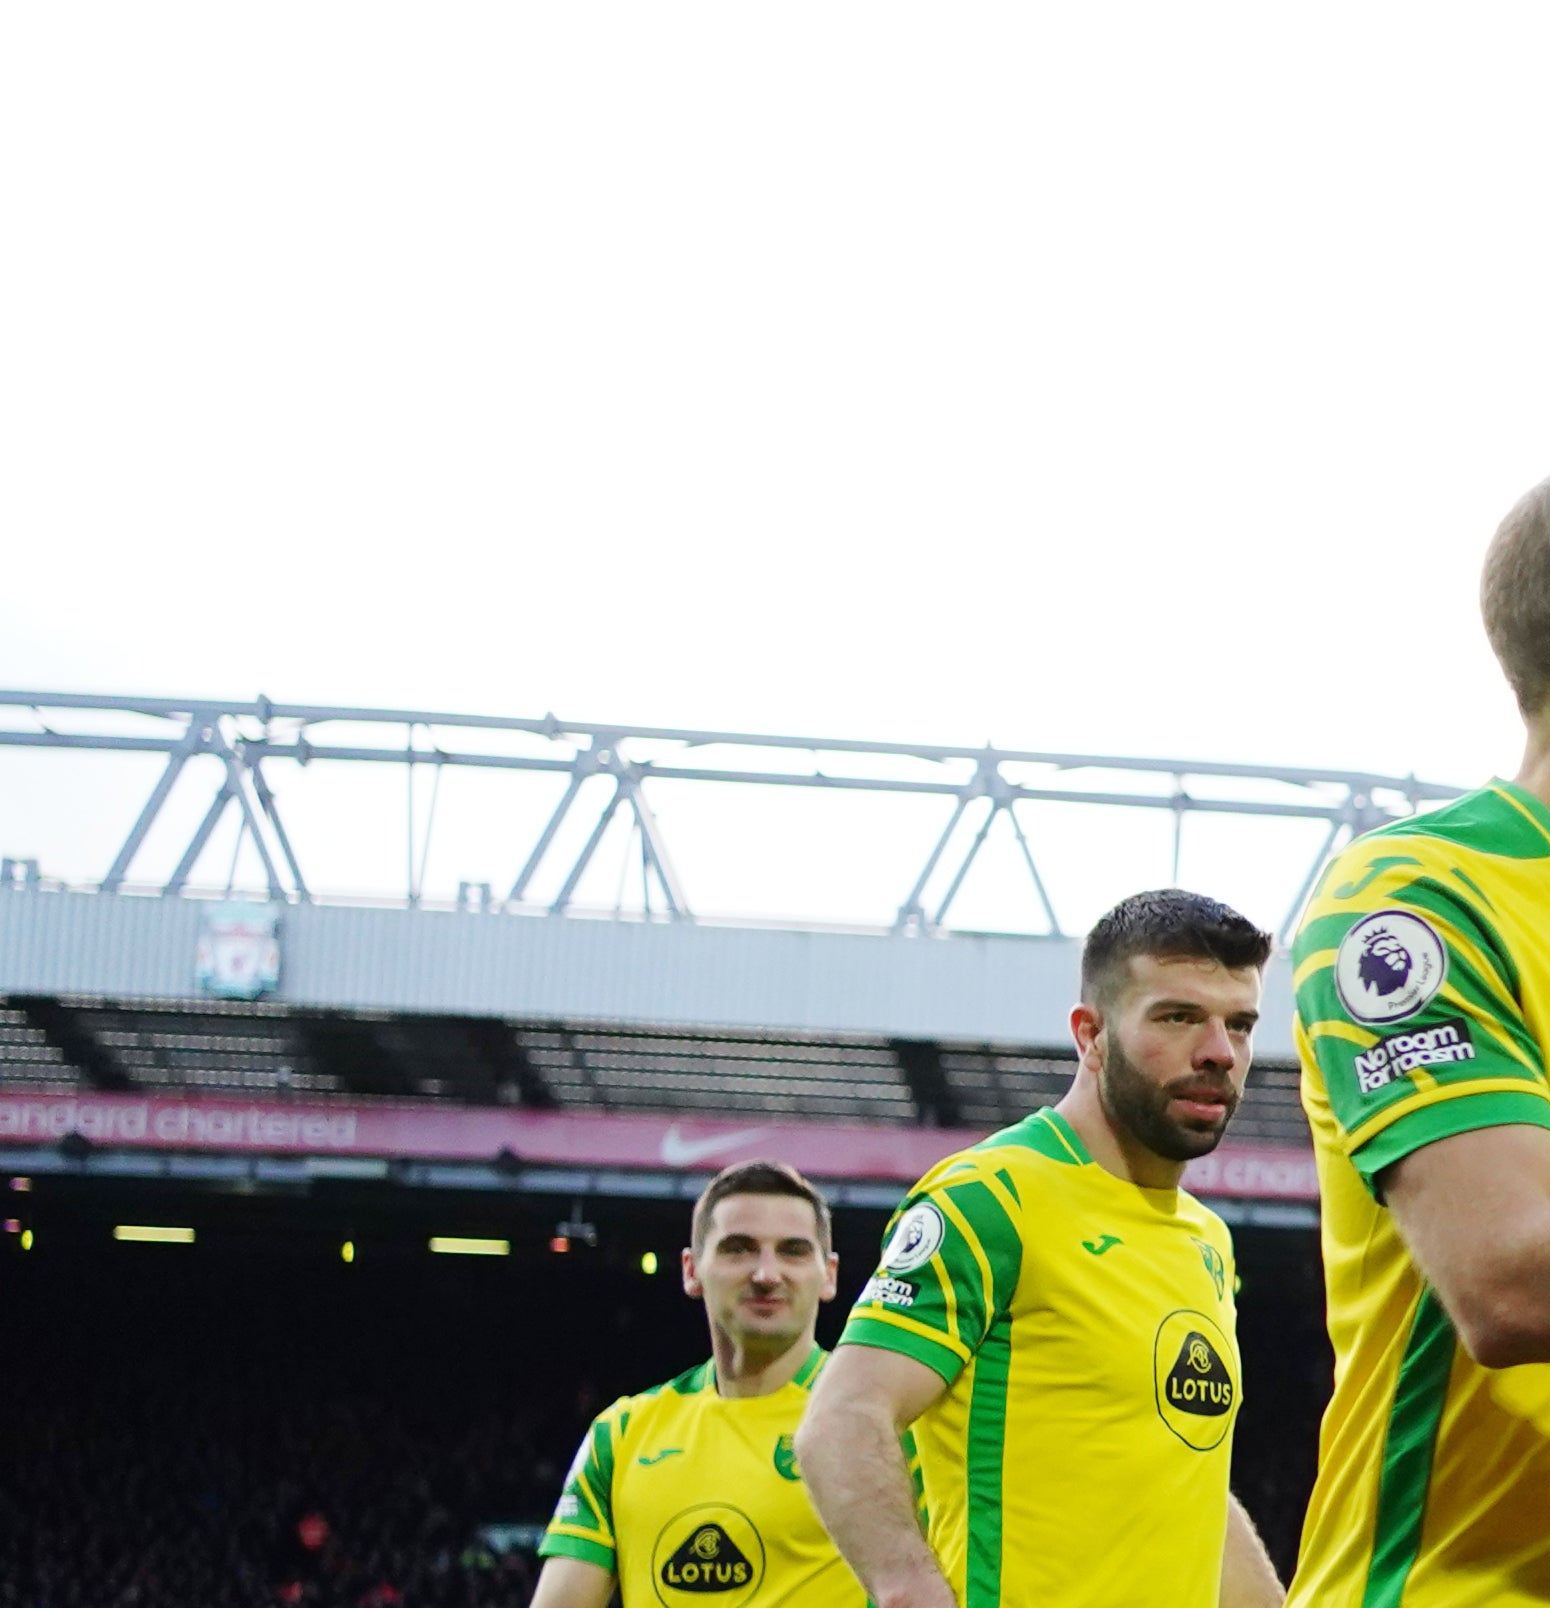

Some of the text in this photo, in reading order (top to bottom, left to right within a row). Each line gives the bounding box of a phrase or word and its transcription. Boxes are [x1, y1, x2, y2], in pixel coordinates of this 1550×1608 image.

[1354, 1025, 1459, 1073] No room
[1357, 1064, 1391, 1094] for
[1171, 1376, 1233, 1406] LOTUS
[666, 1561, 749, 1584] LOTUS
